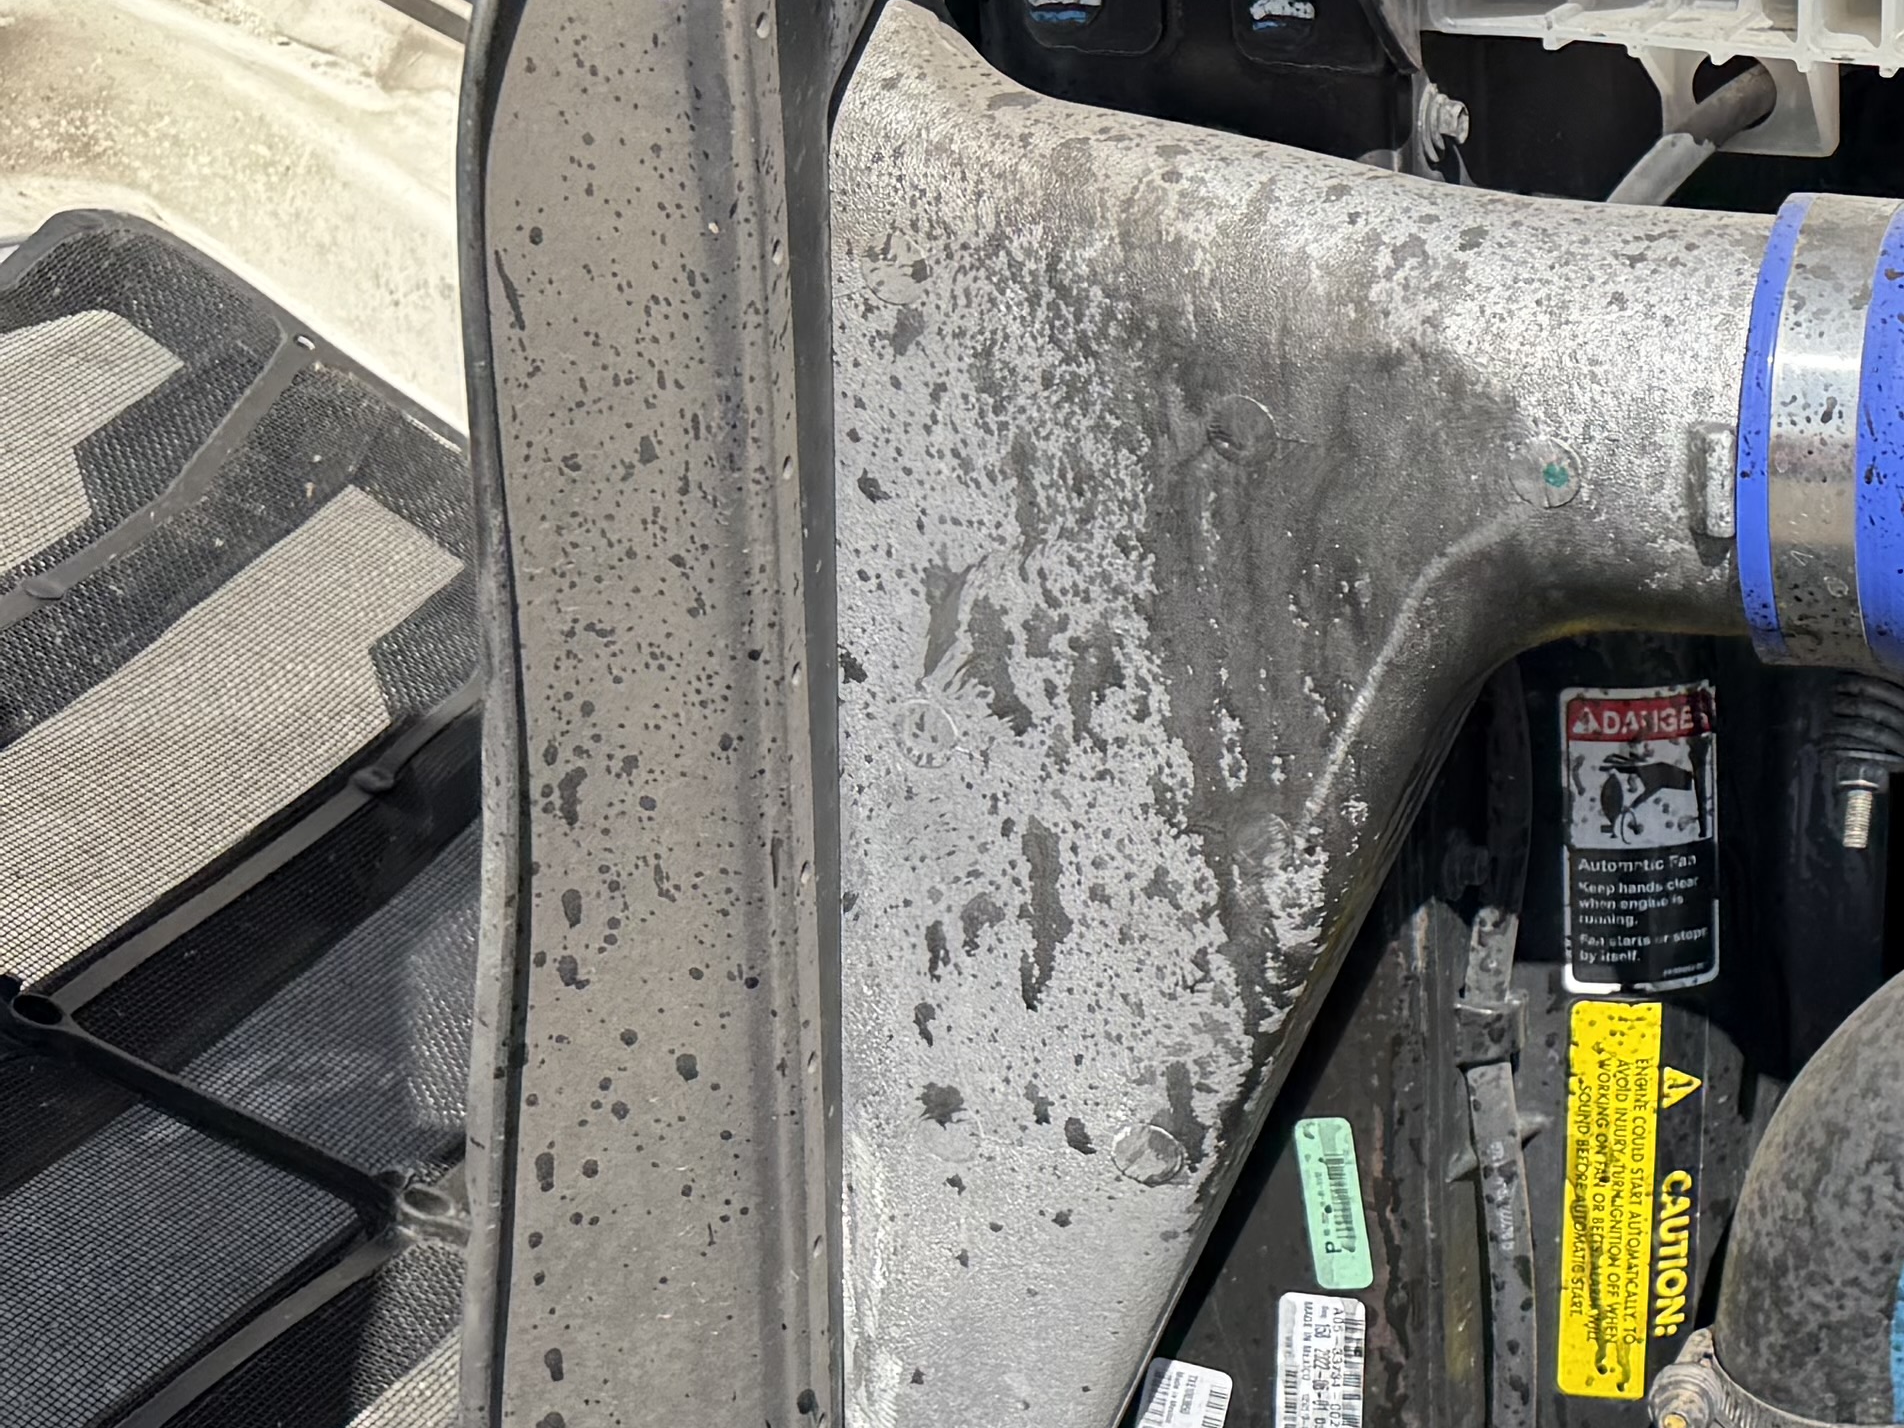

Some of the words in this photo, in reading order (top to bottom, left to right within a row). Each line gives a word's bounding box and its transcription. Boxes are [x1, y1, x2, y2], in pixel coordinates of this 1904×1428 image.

[1578, 858, 1664, 872] Automatic
[1669, 854, 1697, 869] Fan
[1579, 882, 1616, 894] Keep
[1619, 881, 1663, 894] hands
[1666, 878, 1699, 891] clear
[1579, 898, 1616, 910] when
[1620, 897, 1669, 912] engine
[1672, 894, 1684, 905] is
[1579, 914, 1638, 927] running.
[1579, 935, 1605, 947] Fan
[1610, 934, 1651, 947] starts
[1580, 950, 1597, 964] by
[1601, 950, 1640, 962] itself.
[1595, 1056, 1612, 1129] WORKING
[1616, 1059, 1632, 1103] AVOID
[1633, 1058, 1649, 1111] ENGINE
[1576, 1084, 1592, 1134] SOUND
[1594, 1133, 1609, 1155] ON
[1631, 1116, 1647, 1162] COULD
[1575, 1139, 1589, 1190] BEFORE
[1594, 1160, 1609, 1187] FAN
[1629, 1168, 1645, 1205] START
[1592, 1193, 1607, 1212] OR
[1325, 1240, 1342, 1254] P
[1572, 1195, 1587, 1274] AUTOMATIC
[1607, 1208, 1624, 1267] IGNITION
[1654, 1170, 1692, 1337] CAUTION:
[1570, 1276, 1585, 1317] START.
[1607, 1272, 1621, 1297] OFF
[1304, 1301, 1313, 1327] MADE
[1605, 1302, 1620, 1343] WHEN
[1304, 1332, 1312, 1341] IN
[1623, 1327, 1637, 1344] TO
